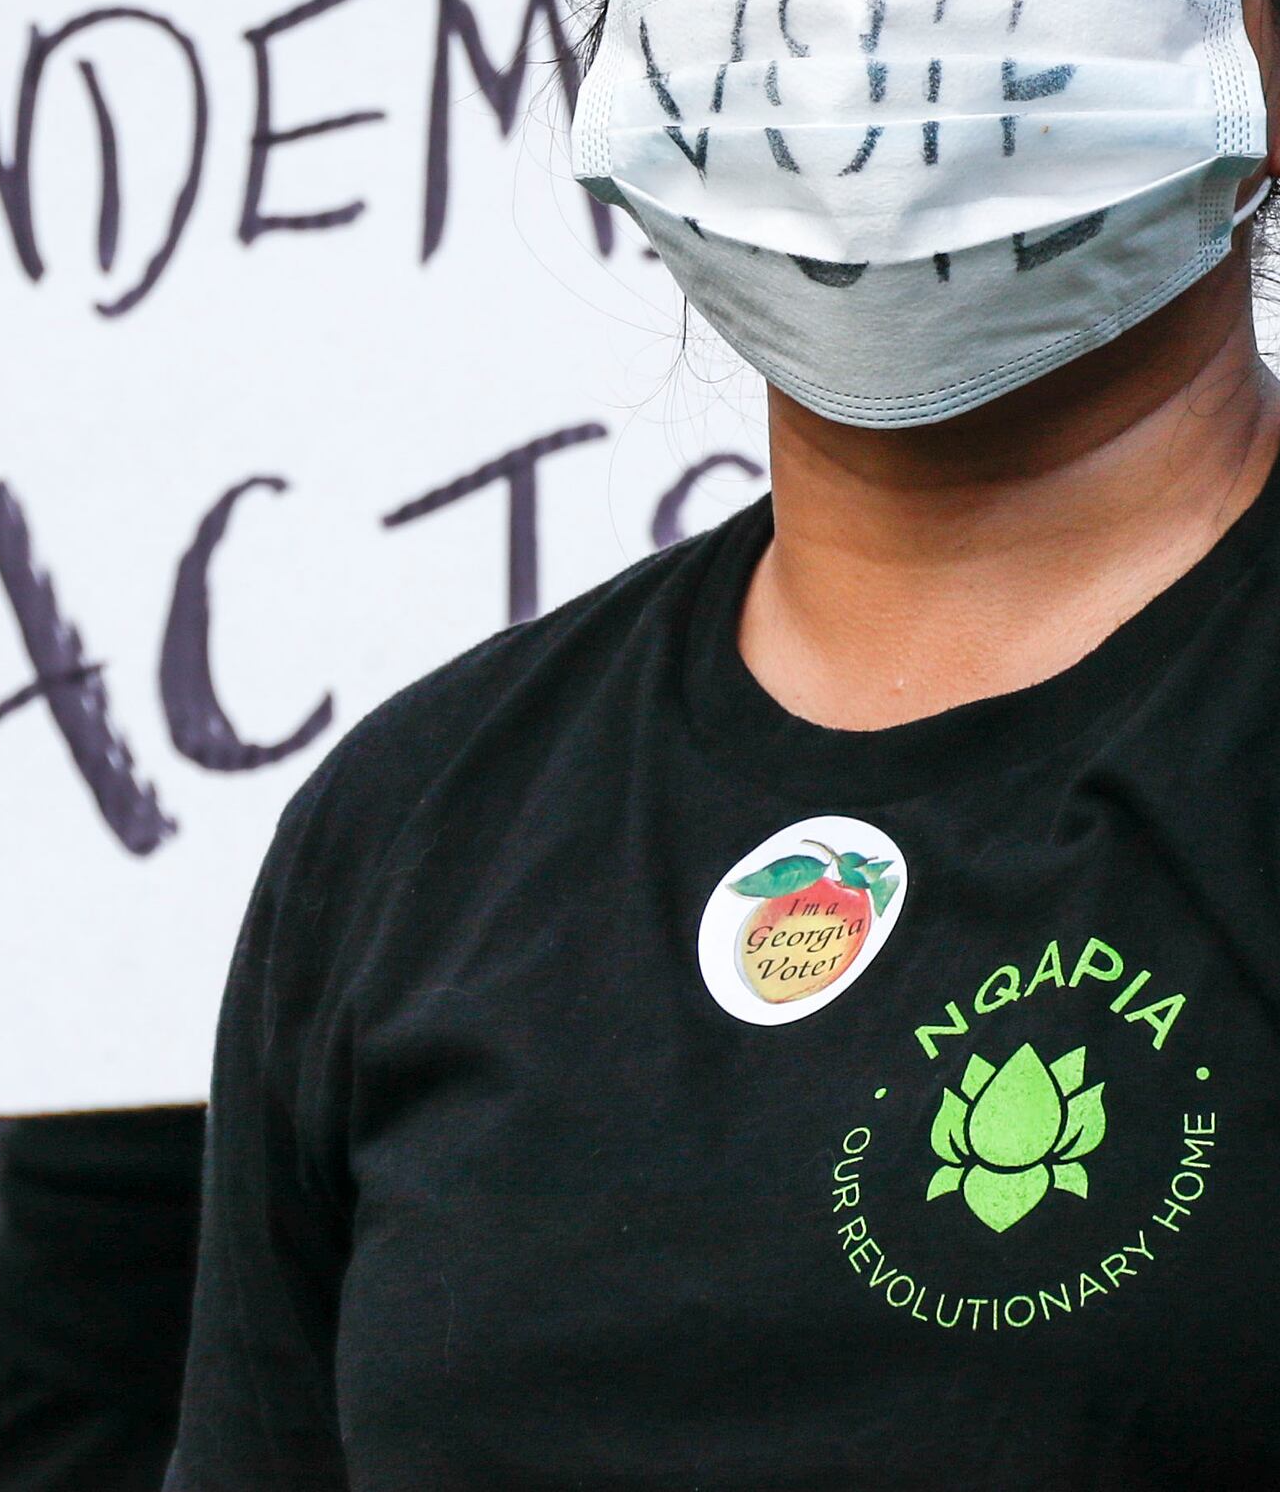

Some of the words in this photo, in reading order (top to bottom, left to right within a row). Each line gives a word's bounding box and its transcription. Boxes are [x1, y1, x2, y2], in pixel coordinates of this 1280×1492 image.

[746, 916, 864, 954] Georgia
[787, 897, 821, 917] I'm
[825, 901, 839, 916] a
[757, 952, 844, 982] Voter
[914, 936, 1187, 1060] NQAPIA
[831, 1126, 872, 1213] OUR
[1151, 1110, 1216, 1233] HOME
[836, 1216, 1156, 1332] REVOLUTIONARY
